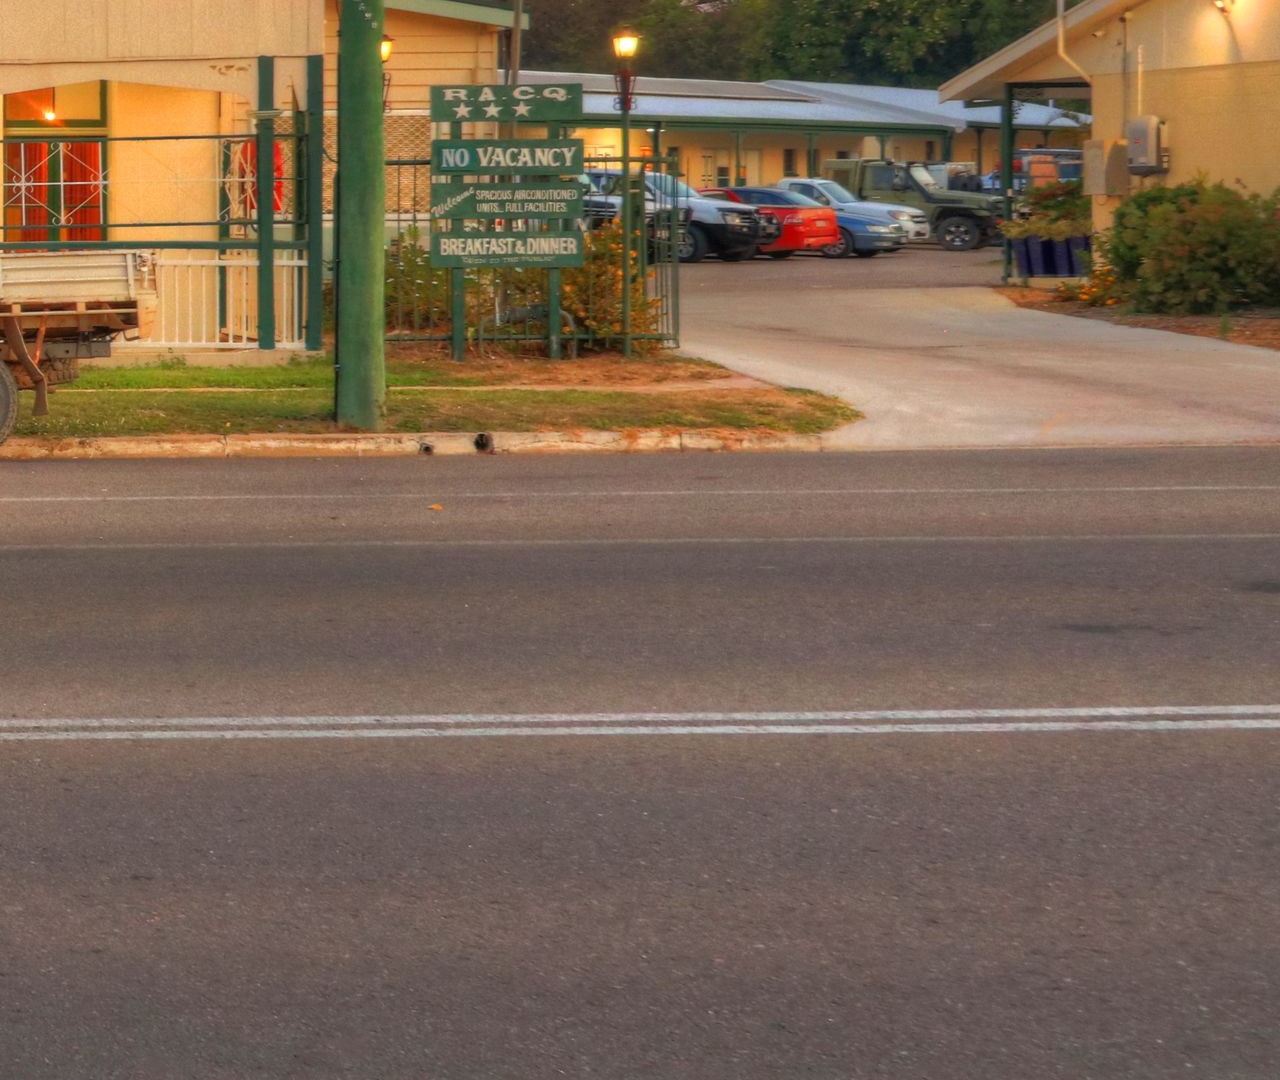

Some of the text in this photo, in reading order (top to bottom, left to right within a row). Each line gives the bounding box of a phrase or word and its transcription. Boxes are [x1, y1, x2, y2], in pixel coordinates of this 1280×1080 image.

[441, 146, 576, 168] NO VACANCY
[475, 189, 512, 201] SPACIOUS
[505, 202, 523, 213] FULL
[440, 236, 578, 256] BREAKFAST & DINNER
